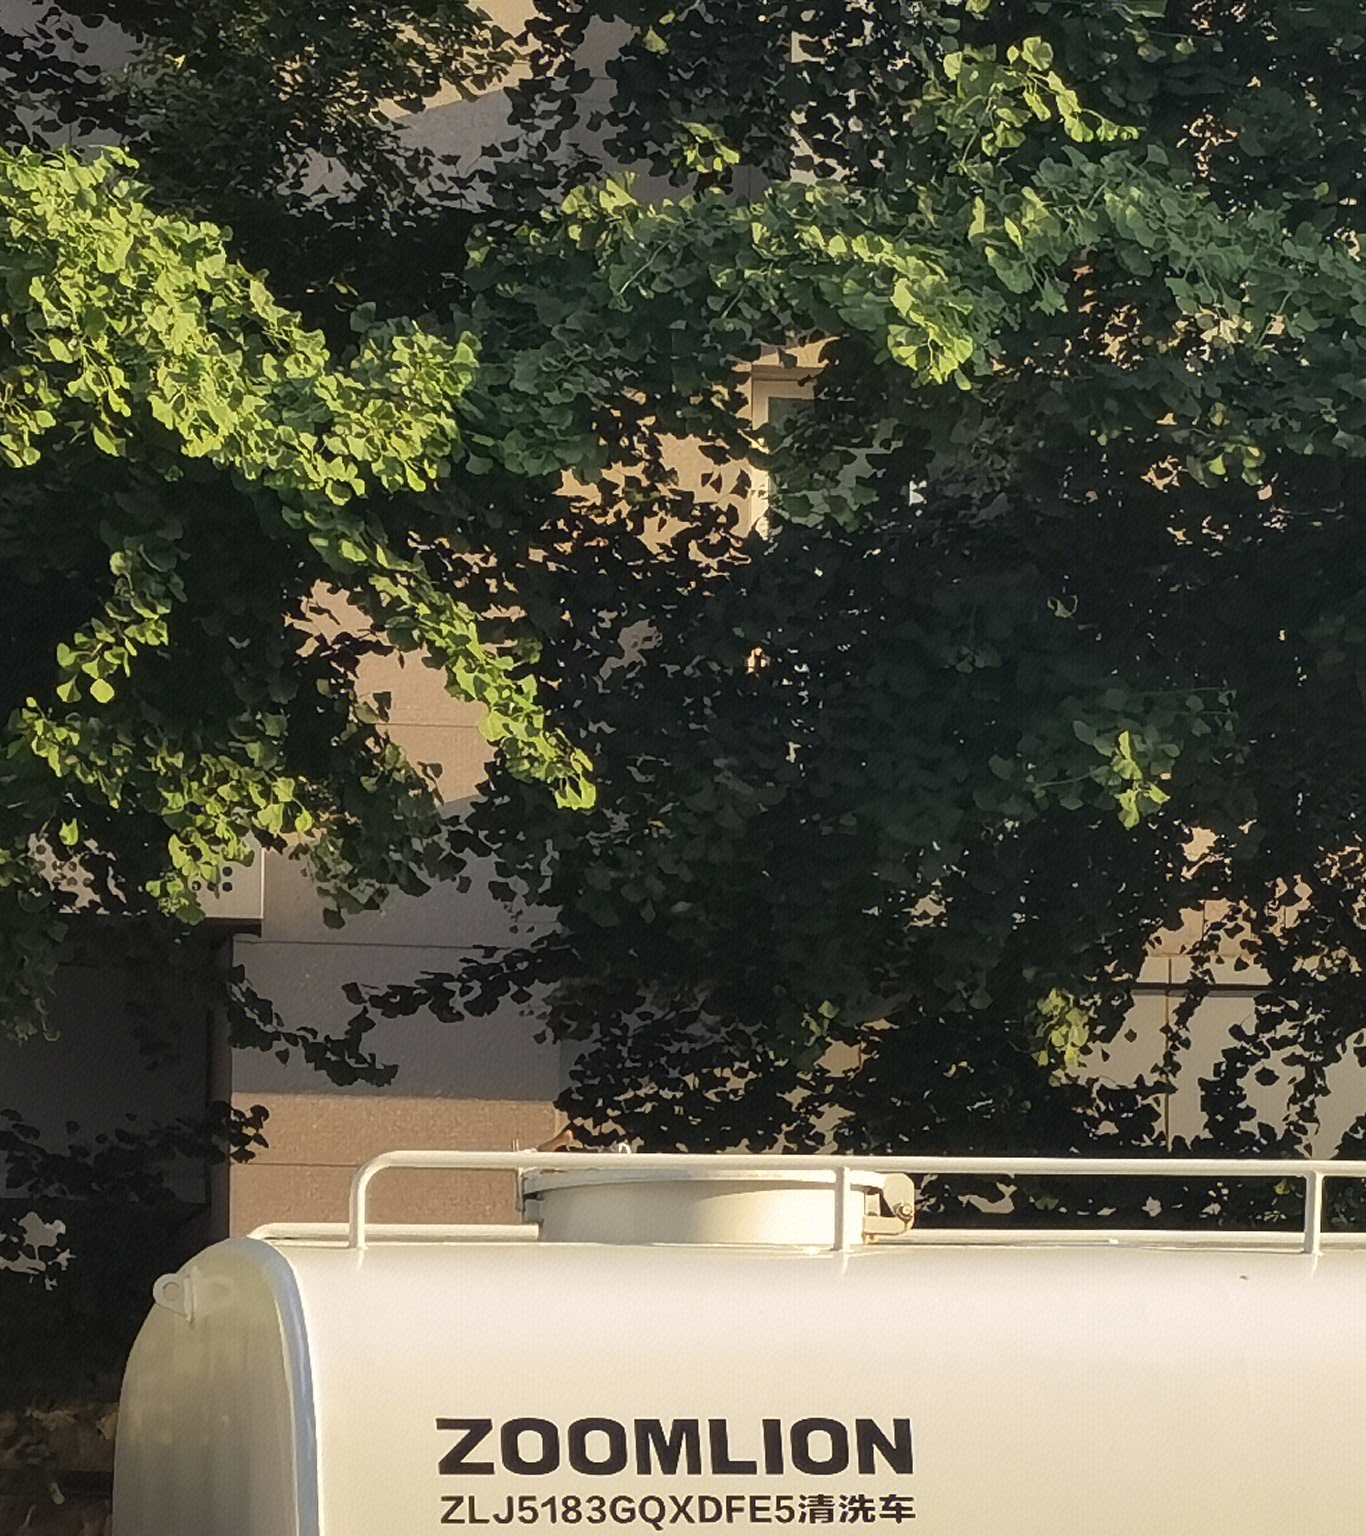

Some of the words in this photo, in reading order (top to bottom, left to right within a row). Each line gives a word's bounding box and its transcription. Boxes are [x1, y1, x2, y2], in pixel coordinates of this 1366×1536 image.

[436, 1417, 913, 1476] ZOOMLION
[440, 1493, 916, 1532] ZLJ5183GQXDFE5清洗车
